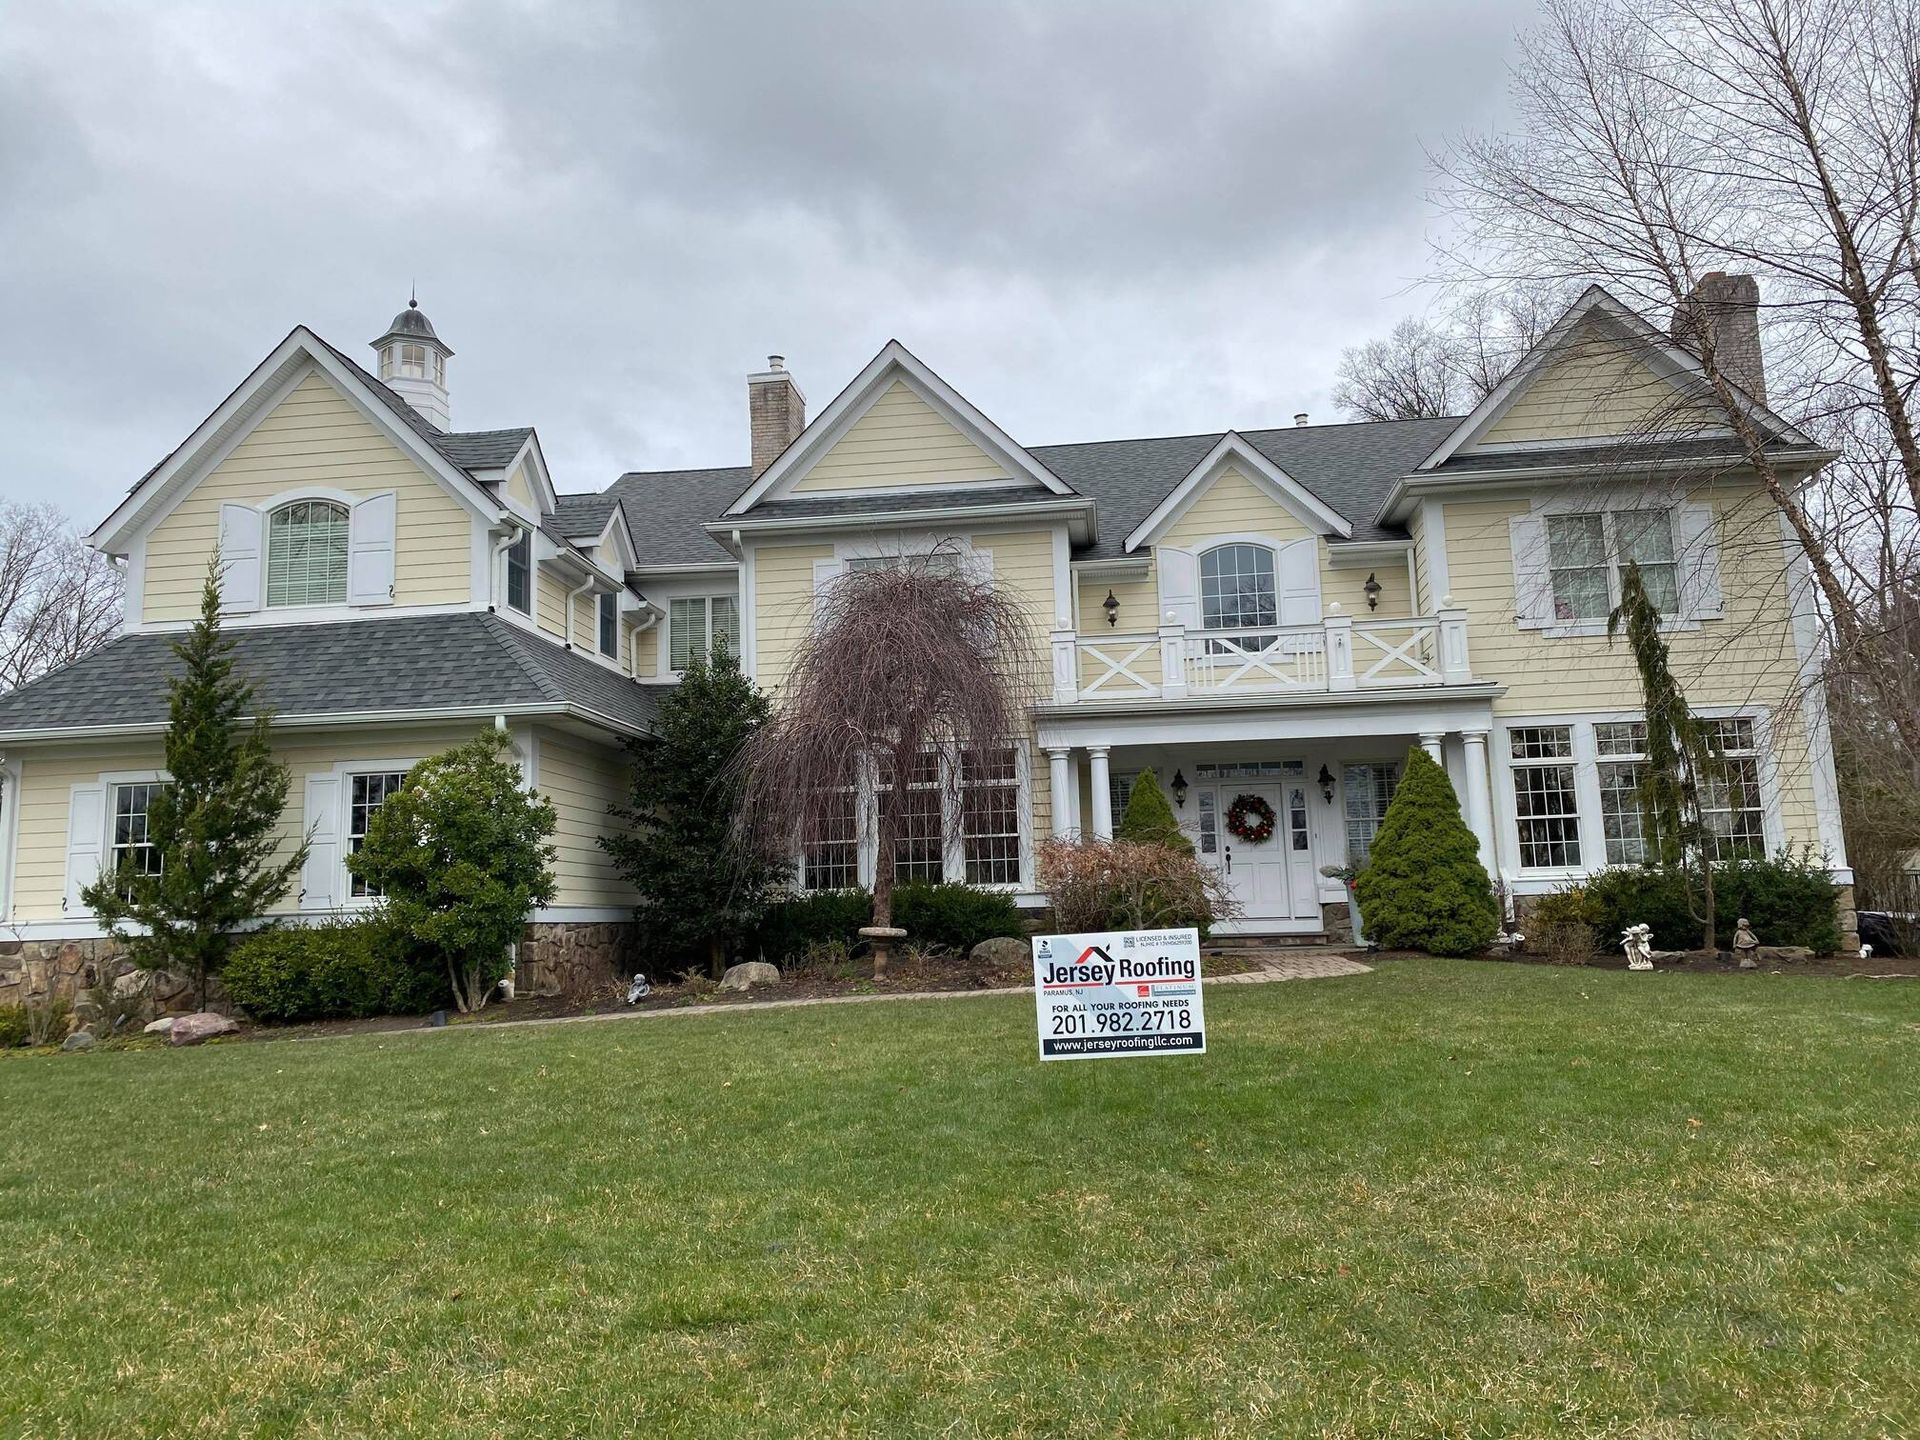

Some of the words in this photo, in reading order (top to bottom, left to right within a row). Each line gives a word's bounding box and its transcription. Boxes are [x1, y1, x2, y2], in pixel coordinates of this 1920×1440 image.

[1043, 962, 1115, 985] Jersey
[1120, 957, 1195, 978] Roofing
[1052, 1004, 1068, 1012] FOR
[1091, 1002, 1115, 1011] YOUR
[1118, 1001, 1159, 1010] ROOFING
[1162, 1000, 1189, 1008] NEEDS
[1052, 1010, 1191, 1035] 201.982.2718
[1054, 1035, 1193, 1054] www.jerseyroofingllc.com
